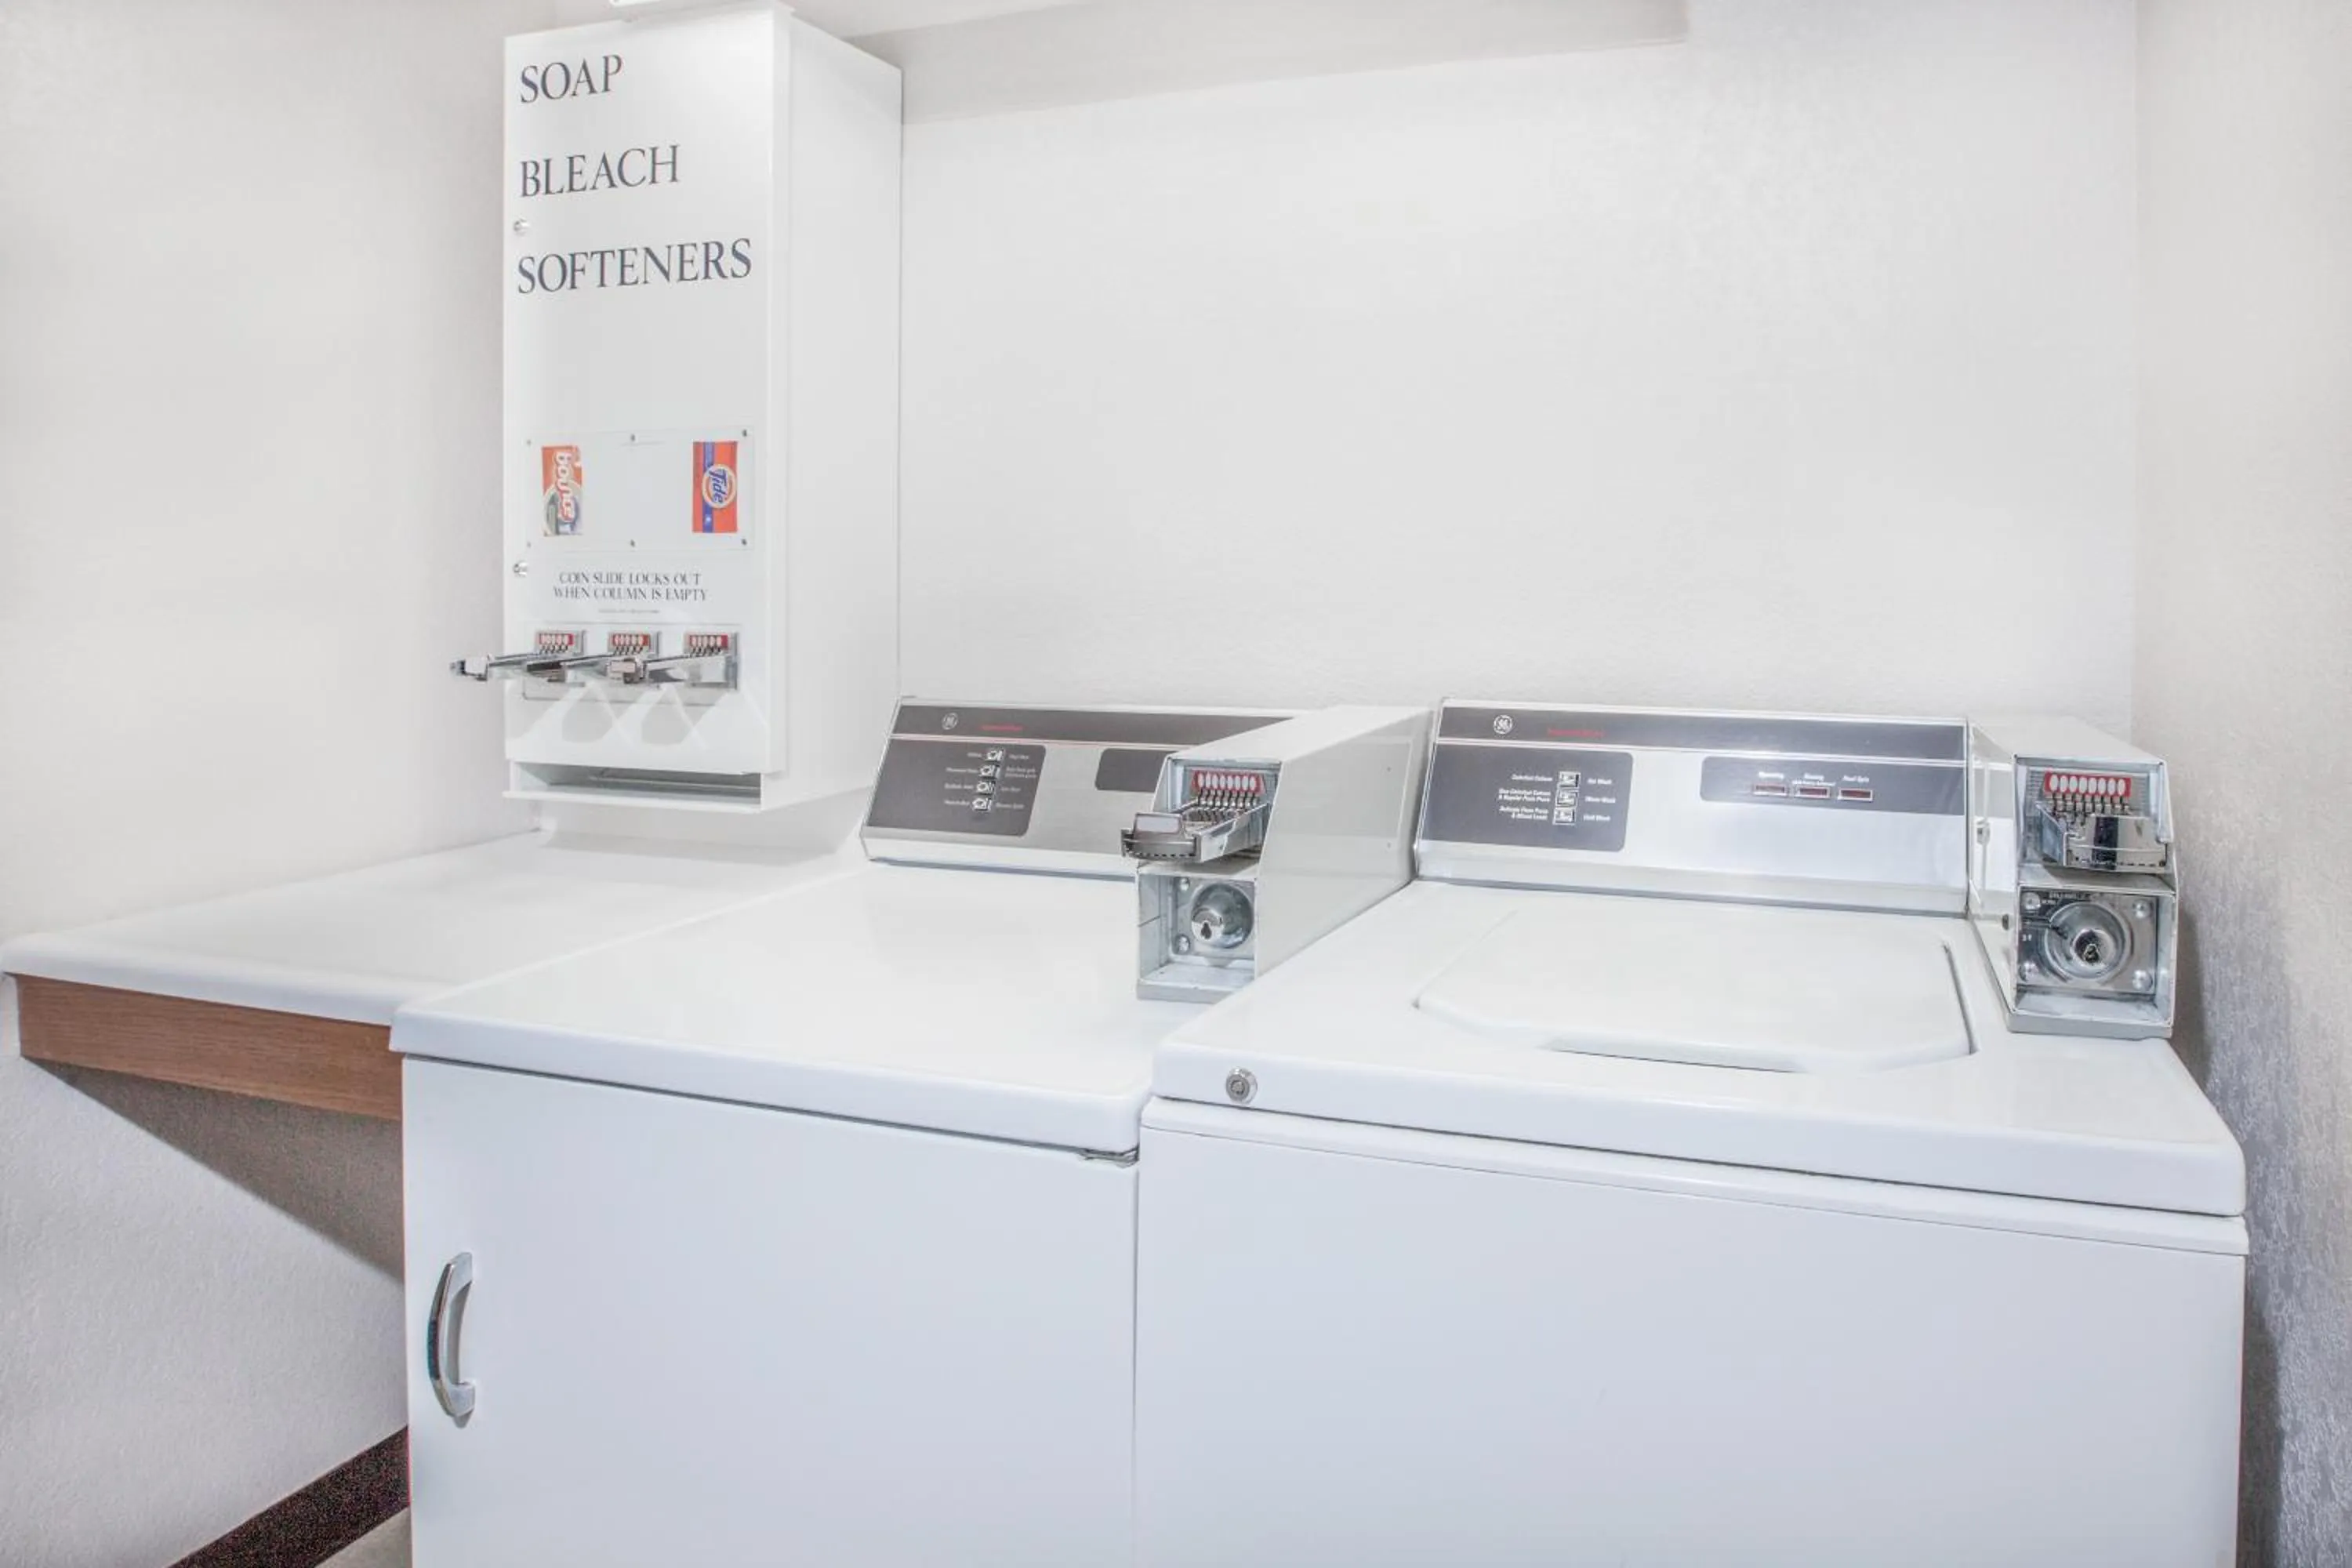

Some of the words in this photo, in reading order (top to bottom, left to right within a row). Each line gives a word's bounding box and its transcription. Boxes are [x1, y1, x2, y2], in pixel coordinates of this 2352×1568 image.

[519, 54, 623, 104] SOAP
[520, 143, 681, 198] BLEACH
[517, 238, 752, 294] SOFTENERS
[708, 468, 728, 503] Tide
[552, 586, 590, 599] WHEN
[593, 586, 647, 601] COLUMN
[652, 588, 662, 601] IS
[666, 588, 708, 601] EMPTY
[559, 572, 590, 584] COIN
[593, 572, 624, 584] SLIDE
[629, 572, 670, 585] LOCKS
[673, 572, 702, 585] OUT
